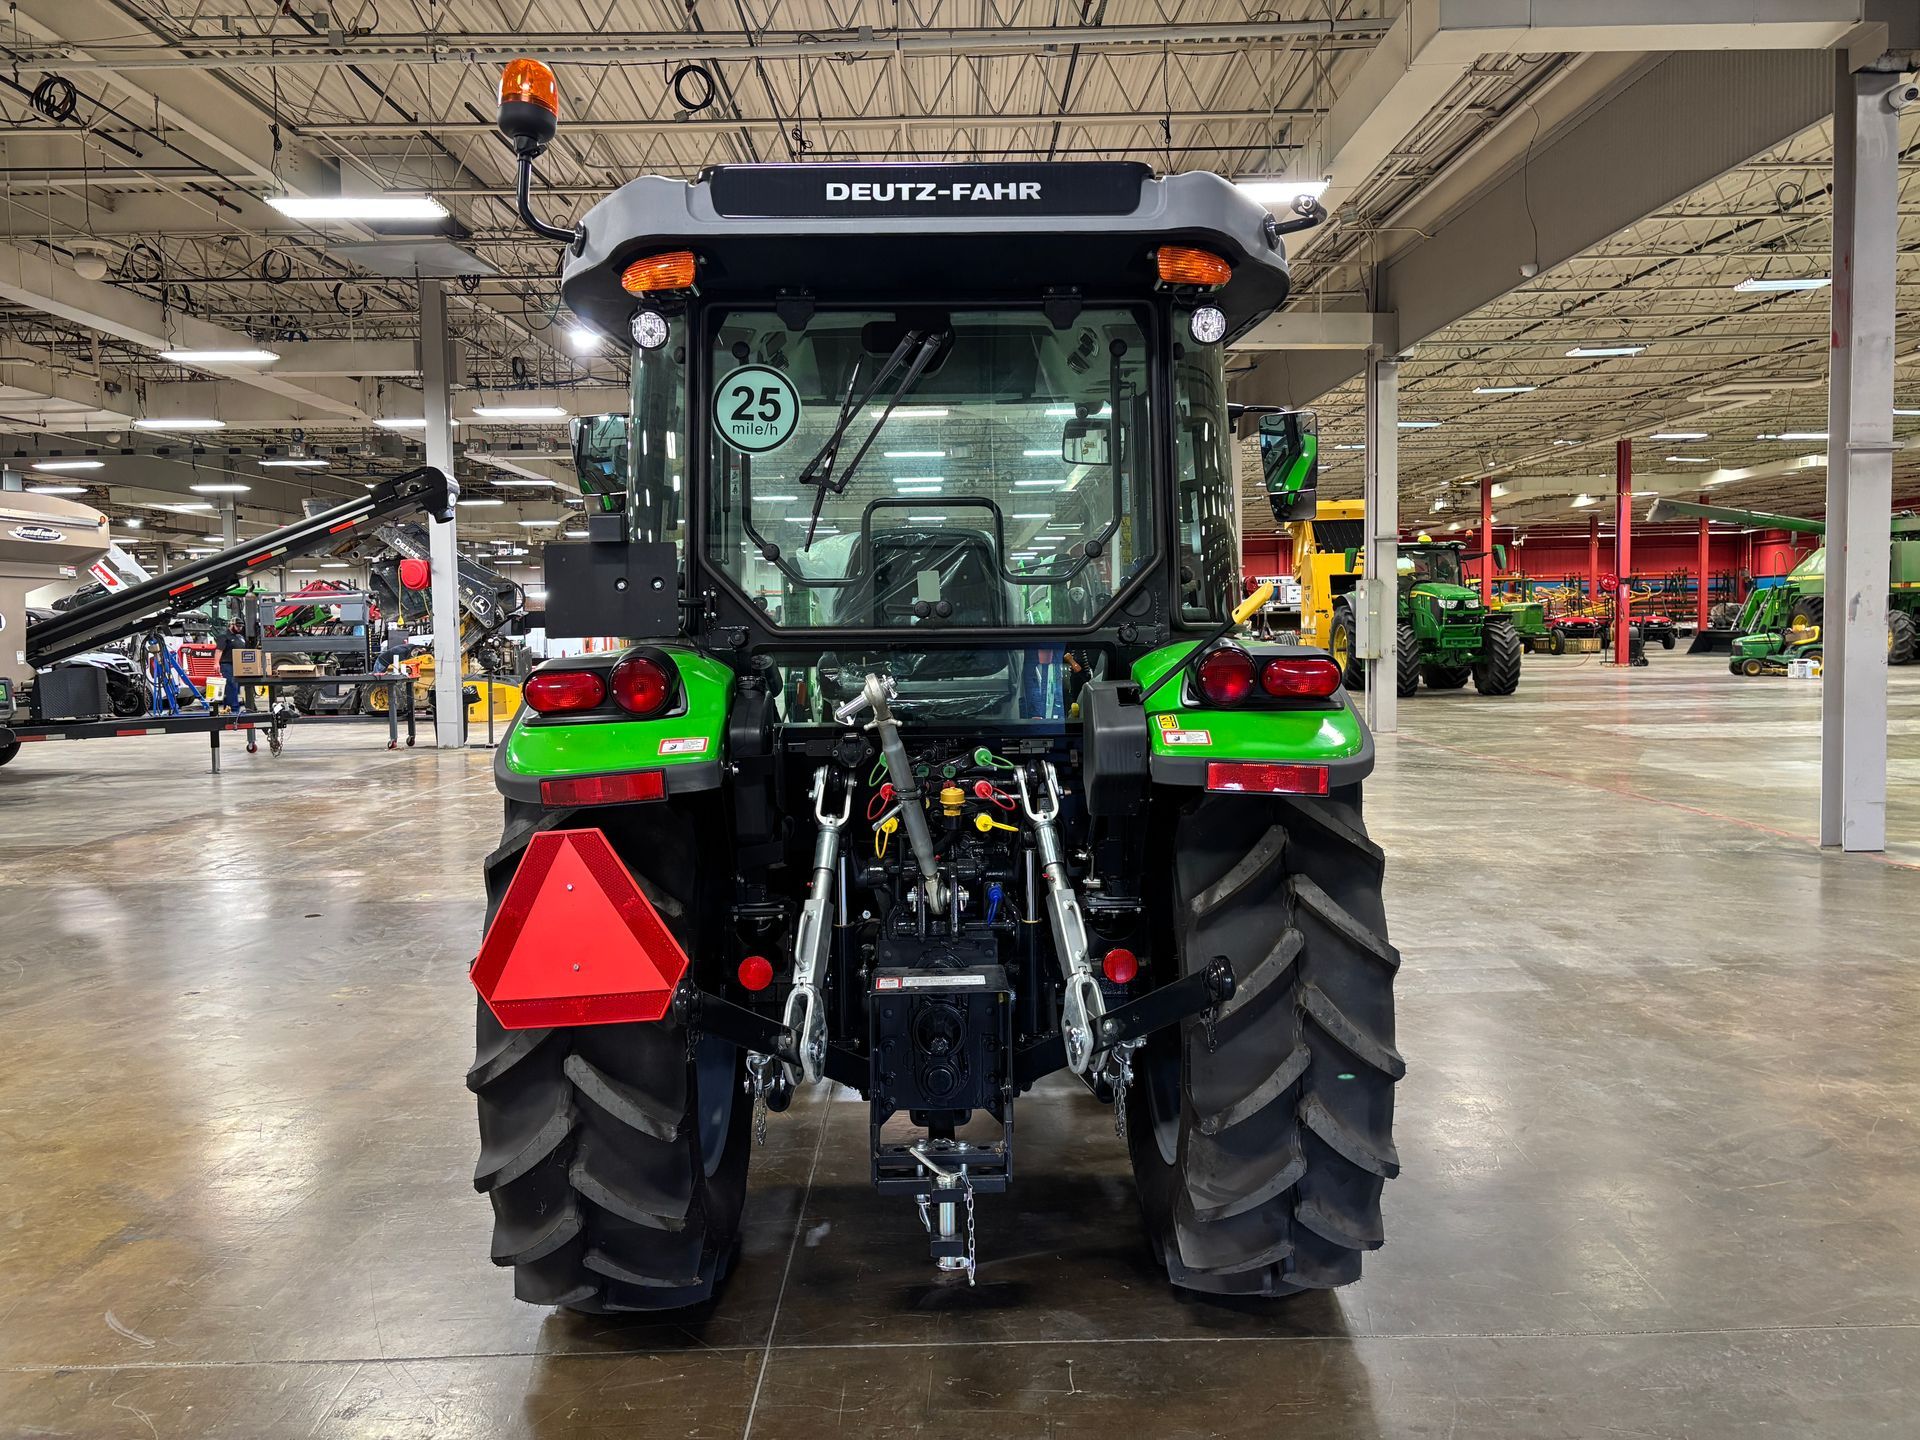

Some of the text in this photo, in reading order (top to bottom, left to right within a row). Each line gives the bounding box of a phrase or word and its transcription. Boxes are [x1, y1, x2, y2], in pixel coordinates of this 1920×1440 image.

[825, 182, 1043, 202] DEUTZ-FAHR
[730, 385, 782, 423] 25
[732, 422, 779, 436] mile/h
[394, 537, 420, 560] DEERE
